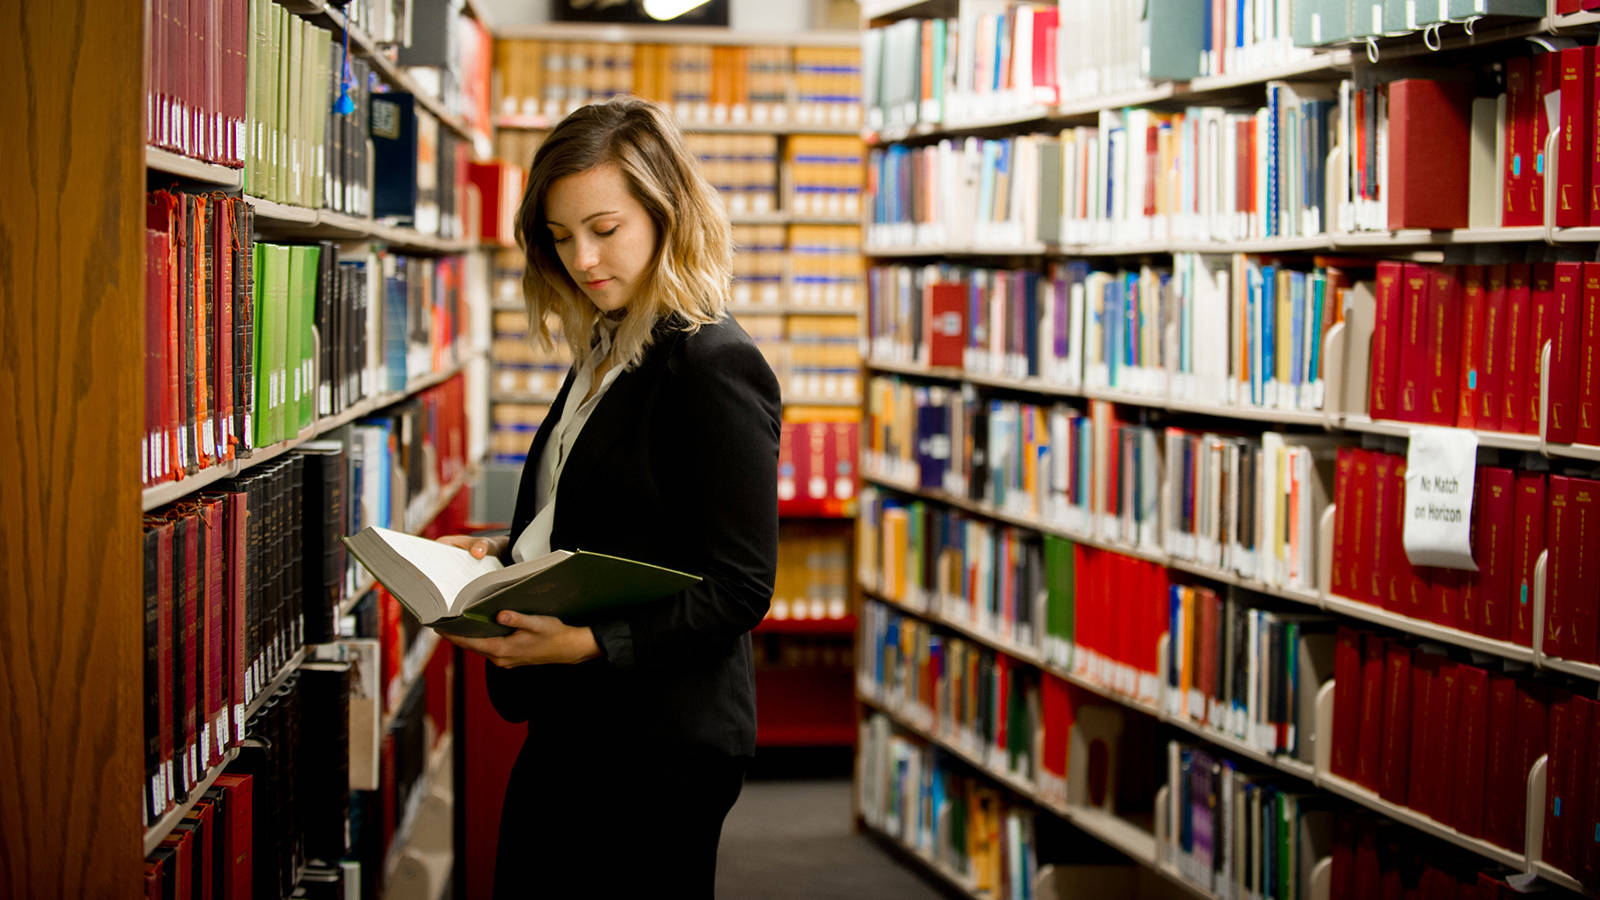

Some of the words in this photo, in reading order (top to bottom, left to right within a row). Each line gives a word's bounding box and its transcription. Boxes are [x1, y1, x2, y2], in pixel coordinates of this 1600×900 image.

[1420, 475, 1431, 492] No
[1433, 476, 1459, 494] Match
[1414, 506, 1425, 519] on
[1428, 503, 1462, 522] Horizon
